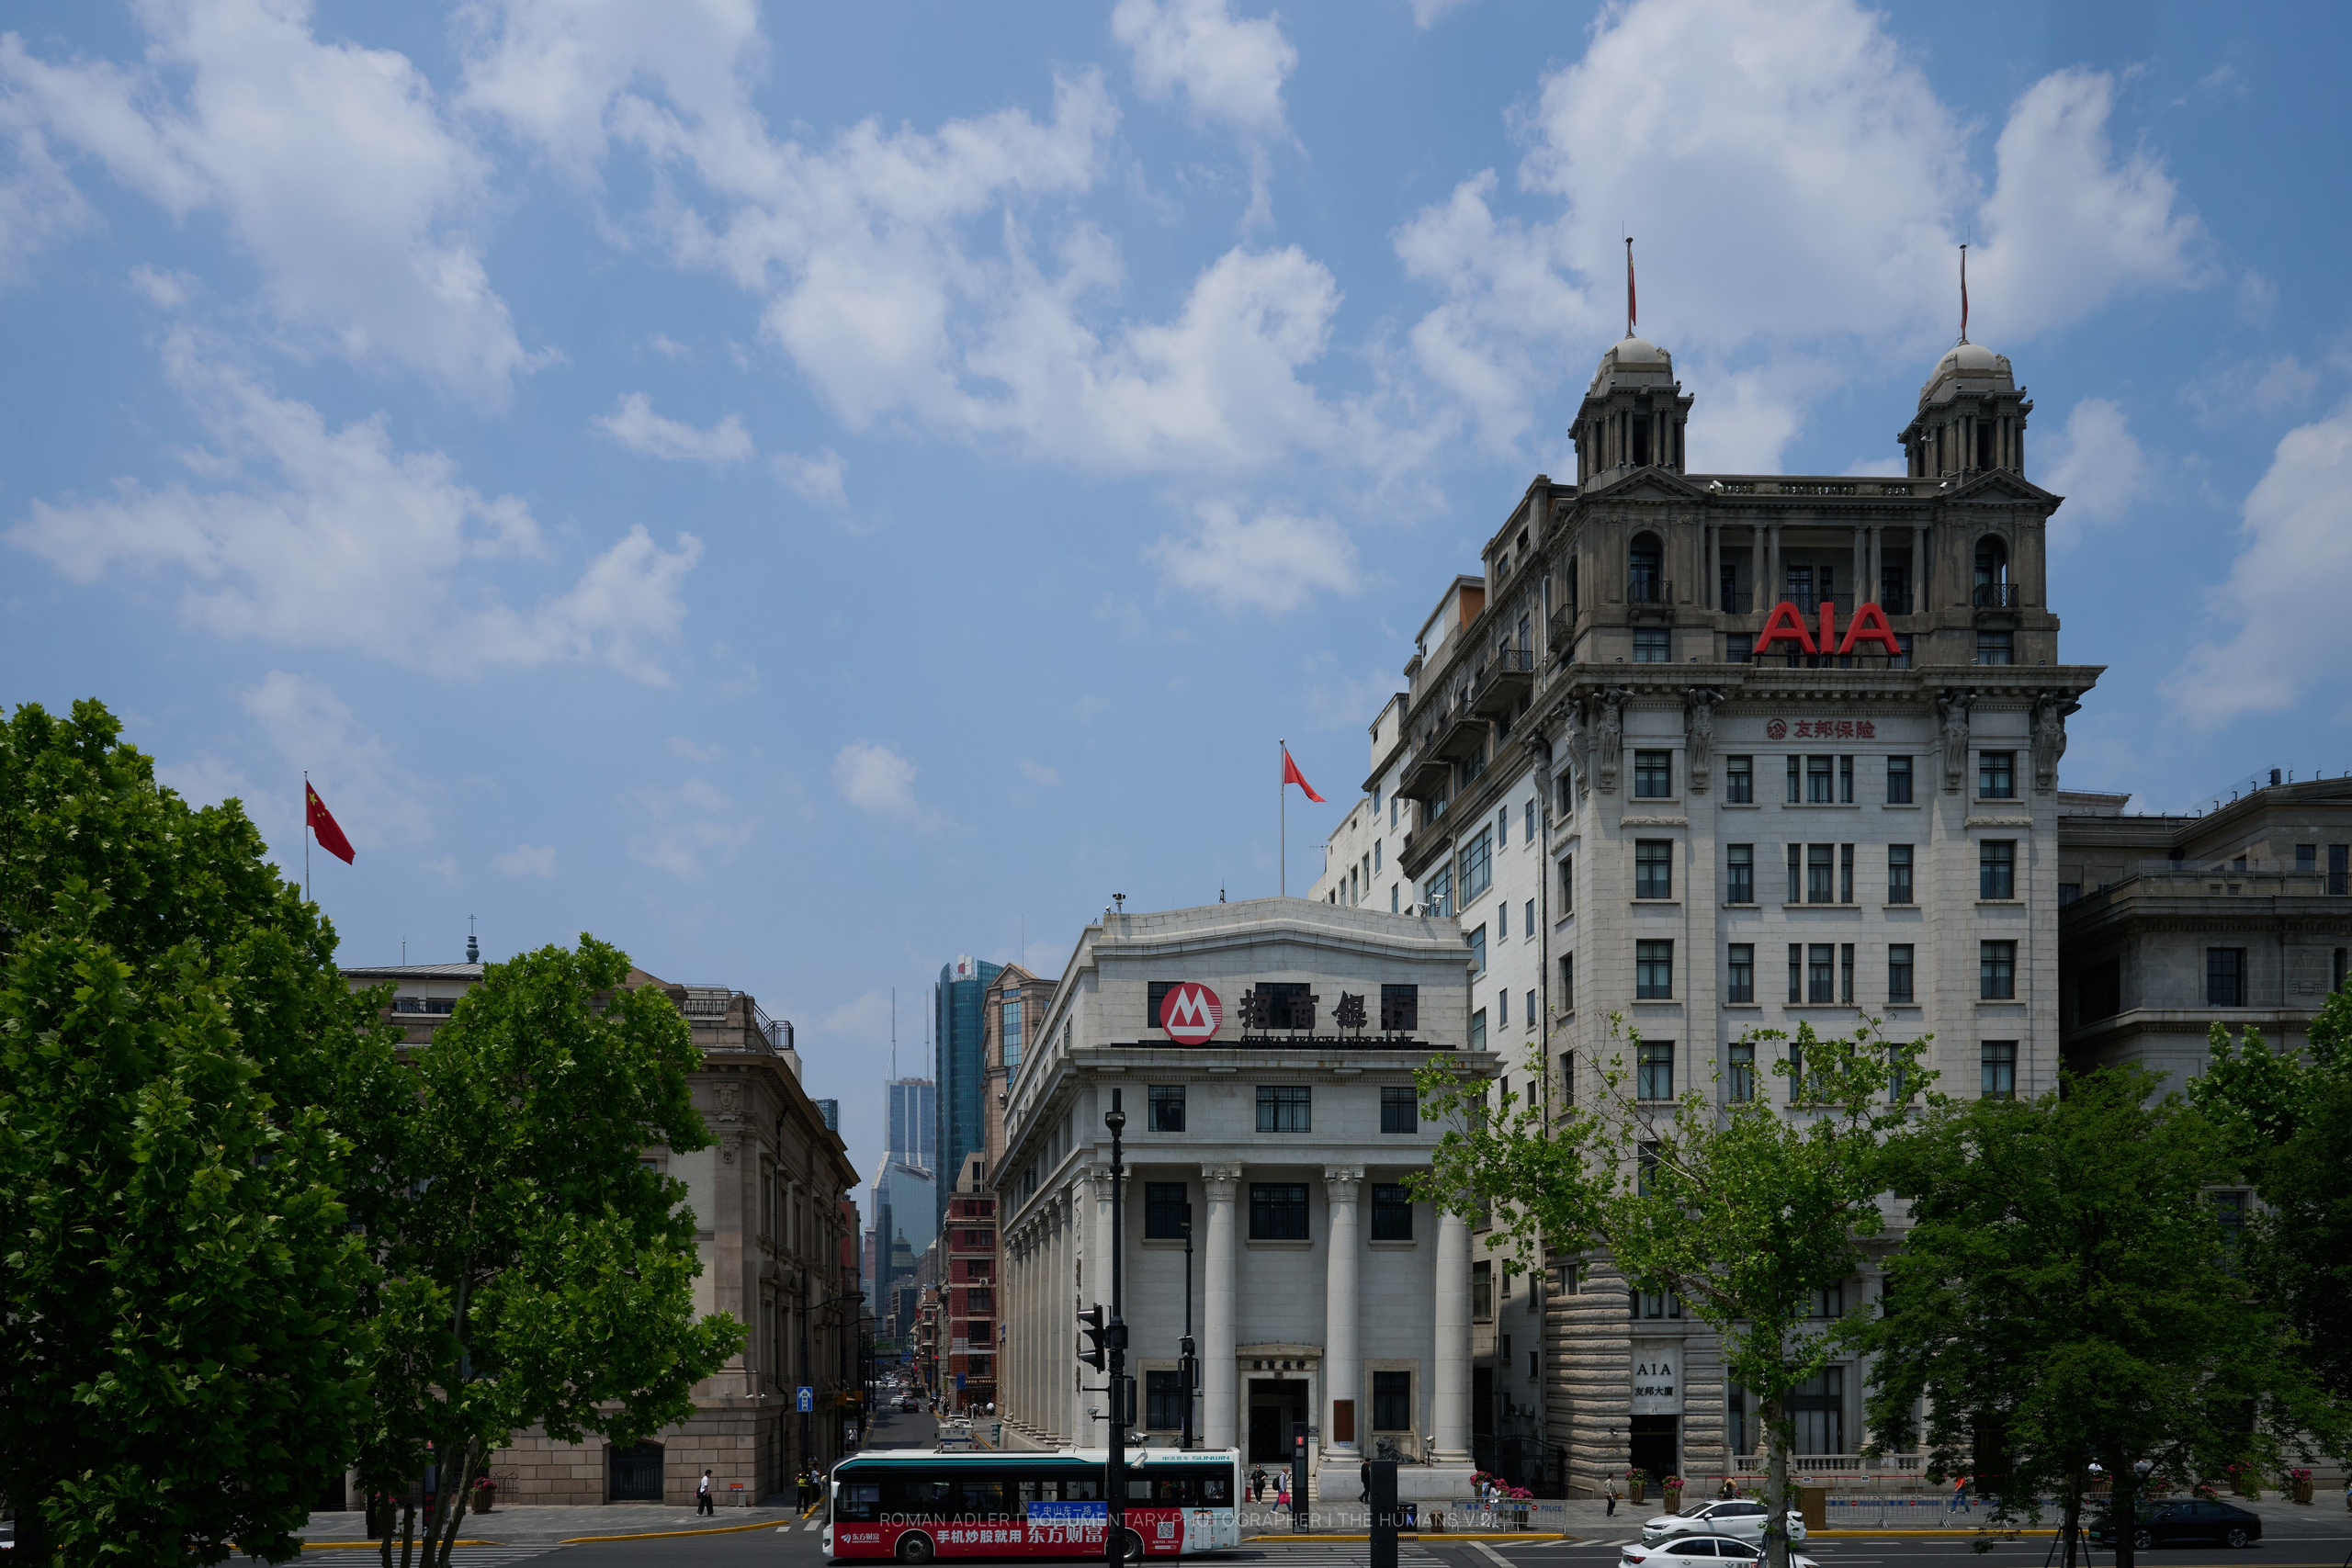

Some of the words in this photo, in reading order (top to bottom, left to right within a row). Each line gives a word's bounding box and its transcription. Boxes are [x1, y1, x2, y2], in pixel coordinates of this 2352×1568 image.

[1753, 602, 1902, 654] AIA
[1793, 720, 1875, 739] 友邦保险
[1240, 1035, 1282, 1046] CHINA
[1287, 1035, 1372, 1046] MERCHANTS
[1375, 1035, 1415, 1046] BANK
[1636, 1363, 1671, 1375] AIA
[1044, 1505, 1091, 1516] 中山东一路
[936, 1529, 1022, 1544] 手机炒股就用
[1027, 1525, 1103, 1543] 东方财富
